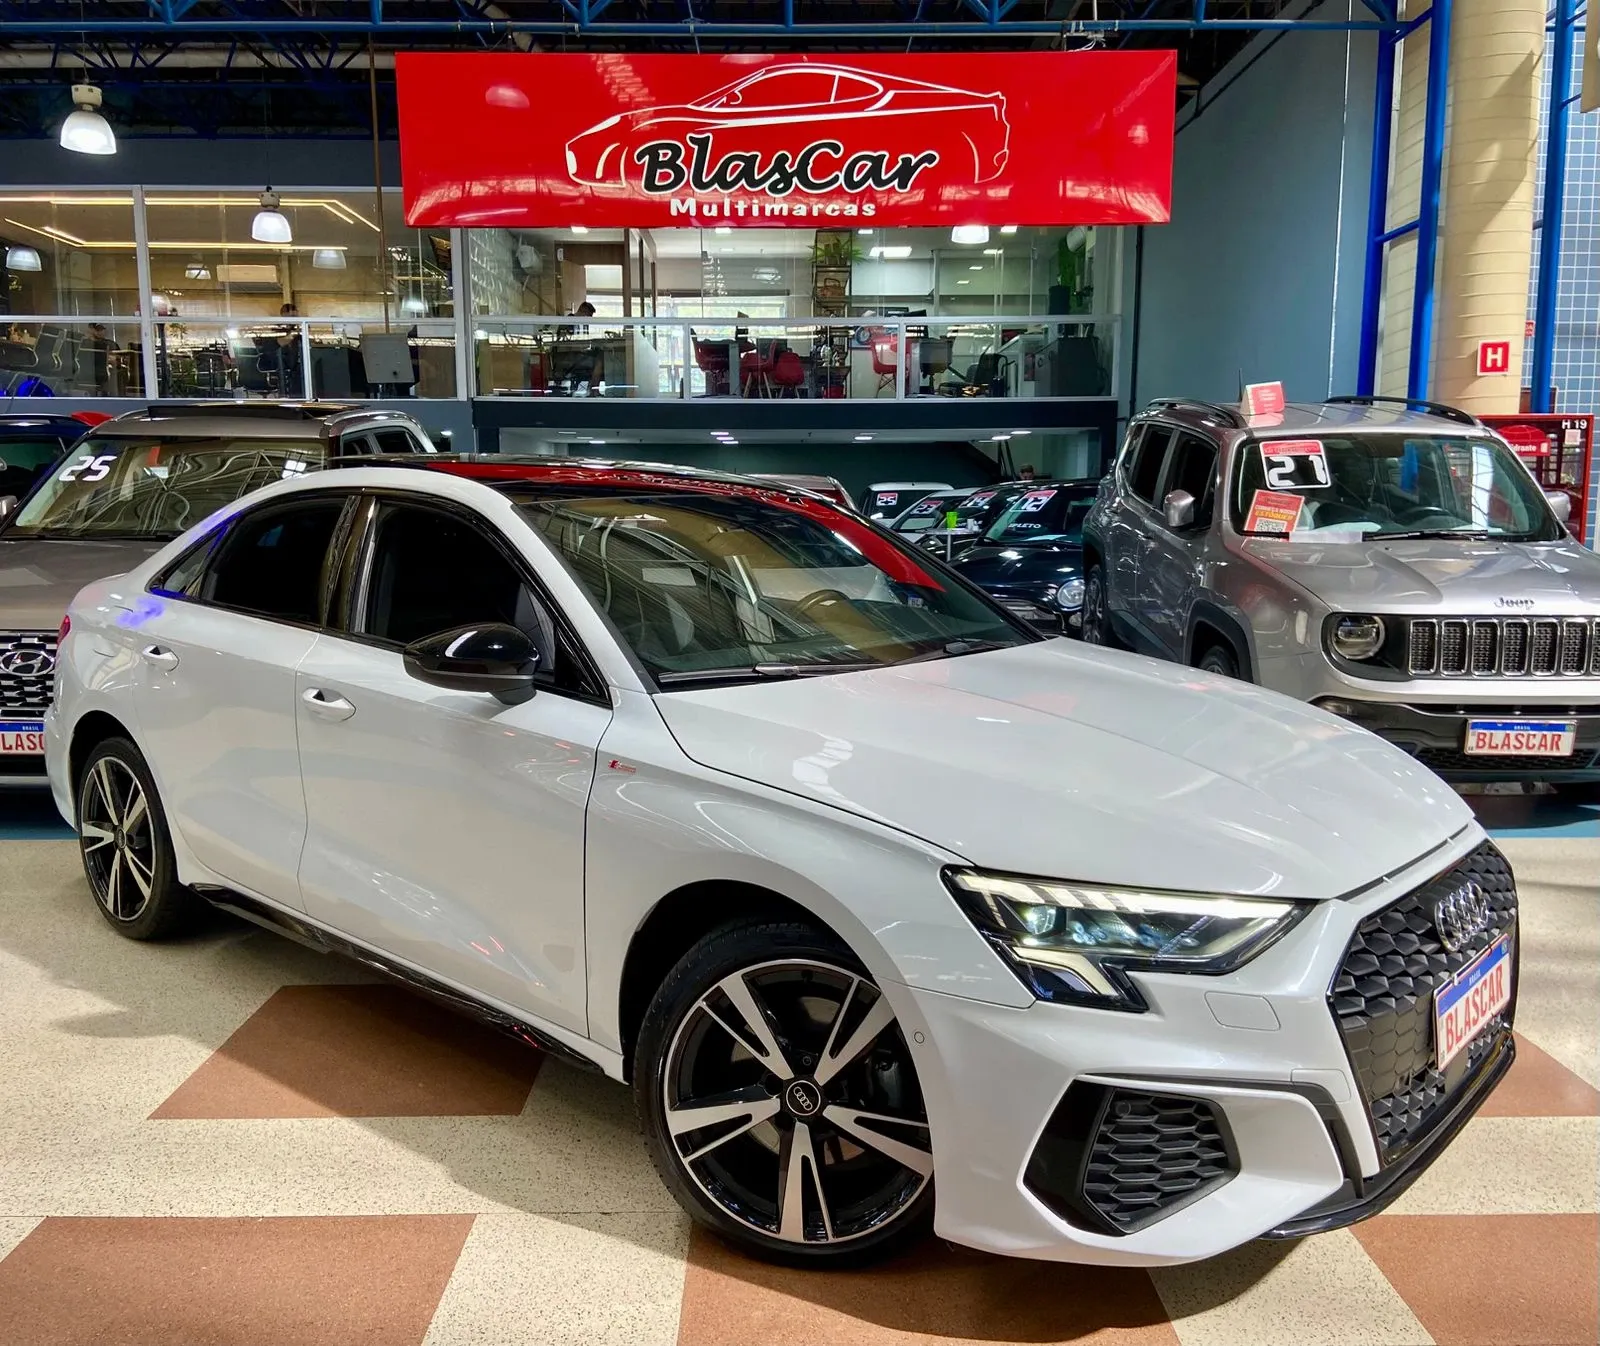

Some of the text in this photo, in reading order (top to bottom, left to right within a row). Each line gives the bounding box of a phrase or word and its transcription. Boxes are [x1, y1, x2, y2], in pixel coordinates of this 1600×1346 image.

[635, 132, 939, 197] BlasCar
[670, 198, 876, 217] Multimarcas
[1486, 347, 1503, 368] H
[1562, 420, 1588, 429] H 19
[1511, 443, 1537, 452] idrante
[59, 455, 118, 481] 25
[1268, 455, 1327, 487] 21
[877, 496, 897, 505] 25
[1020, 496, 1045, 511] 12
[1475, 732, 1562, 752] BLASCAR
[1444, 963, 1504, 1054] BLASCAR
